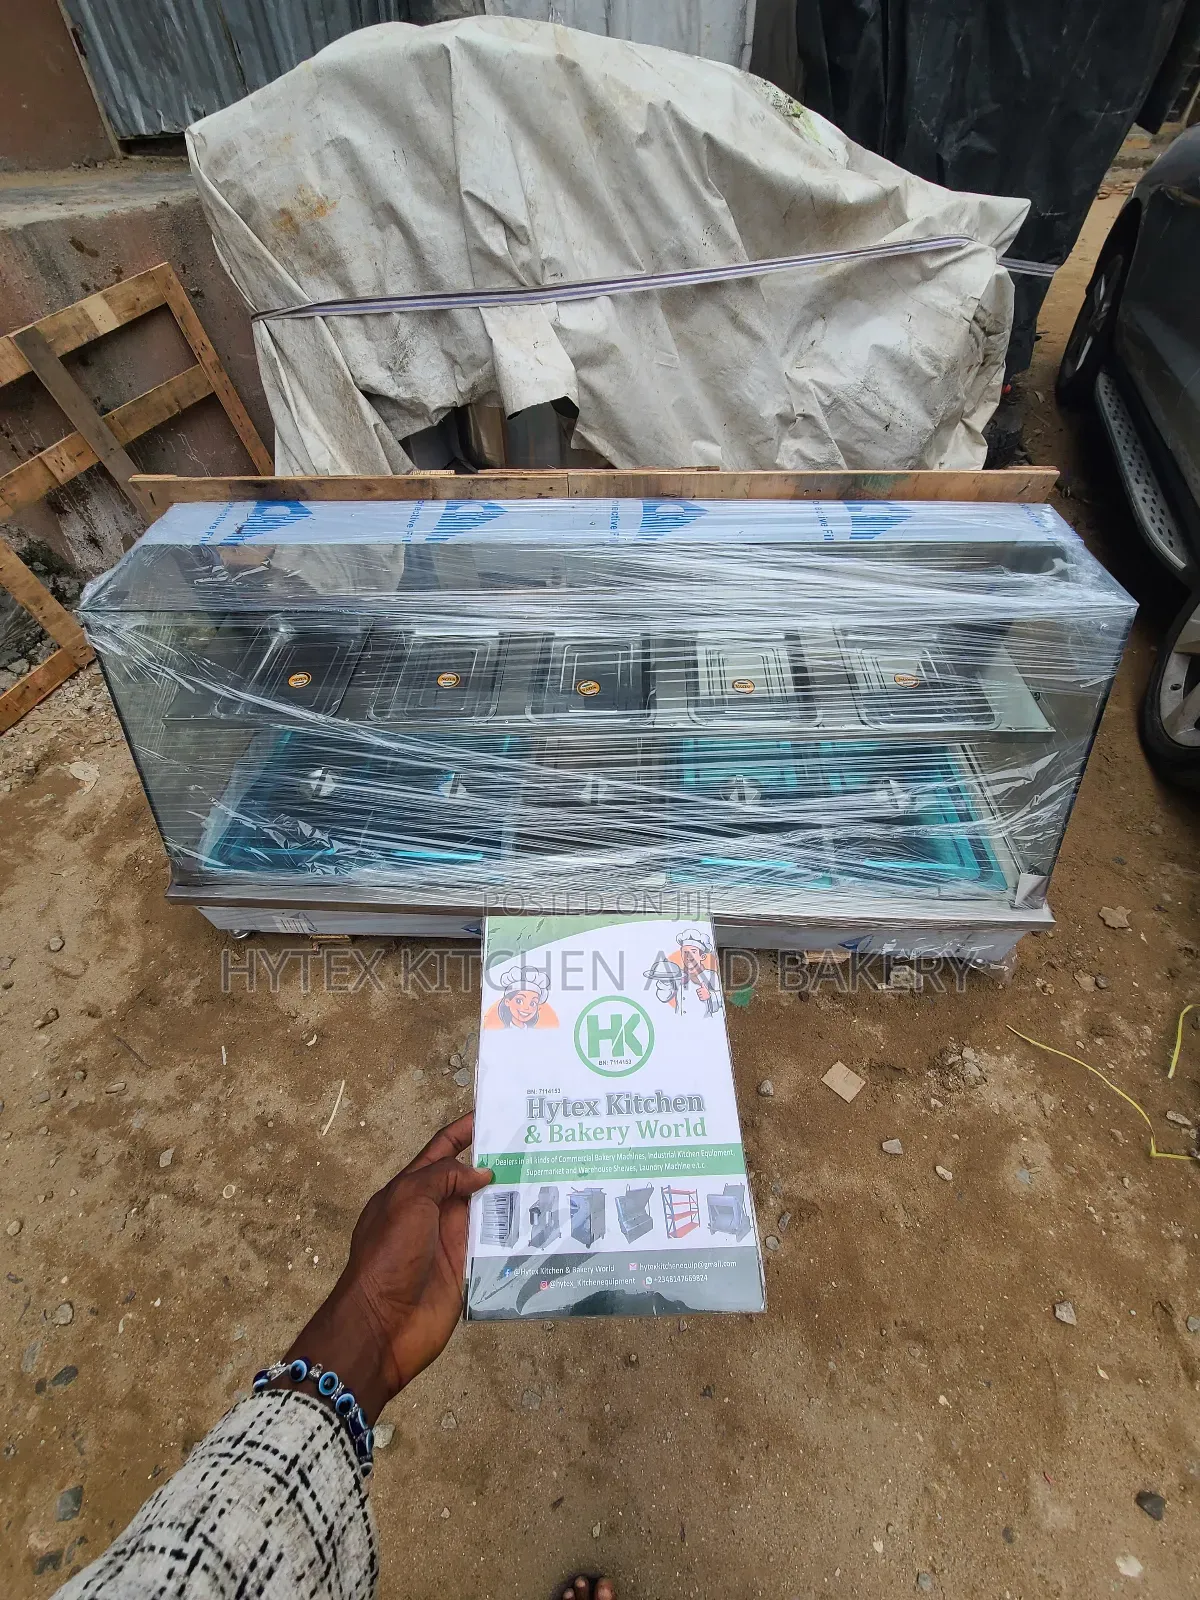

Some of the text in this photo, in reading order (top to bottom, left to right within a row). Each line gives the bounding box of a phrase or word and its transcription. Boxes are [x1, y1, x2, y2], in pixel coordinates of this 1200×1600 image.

[586, 1013, 643, 1058] HK
[526, 1090, 706, 1124] Hytex Kitchen
[524, 1117, 708, 1146] & Bakery World
[495, 1158, 518, 1166] Dealers
[518, 1157, 525, 1165] in
[551, 1155, 558, 1163] of
[559, 1154, 594, 1163] Commercial
[594, 1153, 615, 1162] Bakery
[648, 1150, 676, 1159] Industrial
[677, 1149, 700, 1158] Kitchen
[526, 1168, 565, 1177] Supermarket
[565, 1166, 577, 1175] and
[578, 1164, 613, 1174] Warehouse
[639, 1162, 664, 1172] Laundry
[664, 1160, 691, 1170] Machine
[541, 1266, 564, 1275] Kitchen
[565, 1266, 571, 1274] &
[572, 1265, 595, 1275] Bakery
[596, 1264, 615, 1272] World
